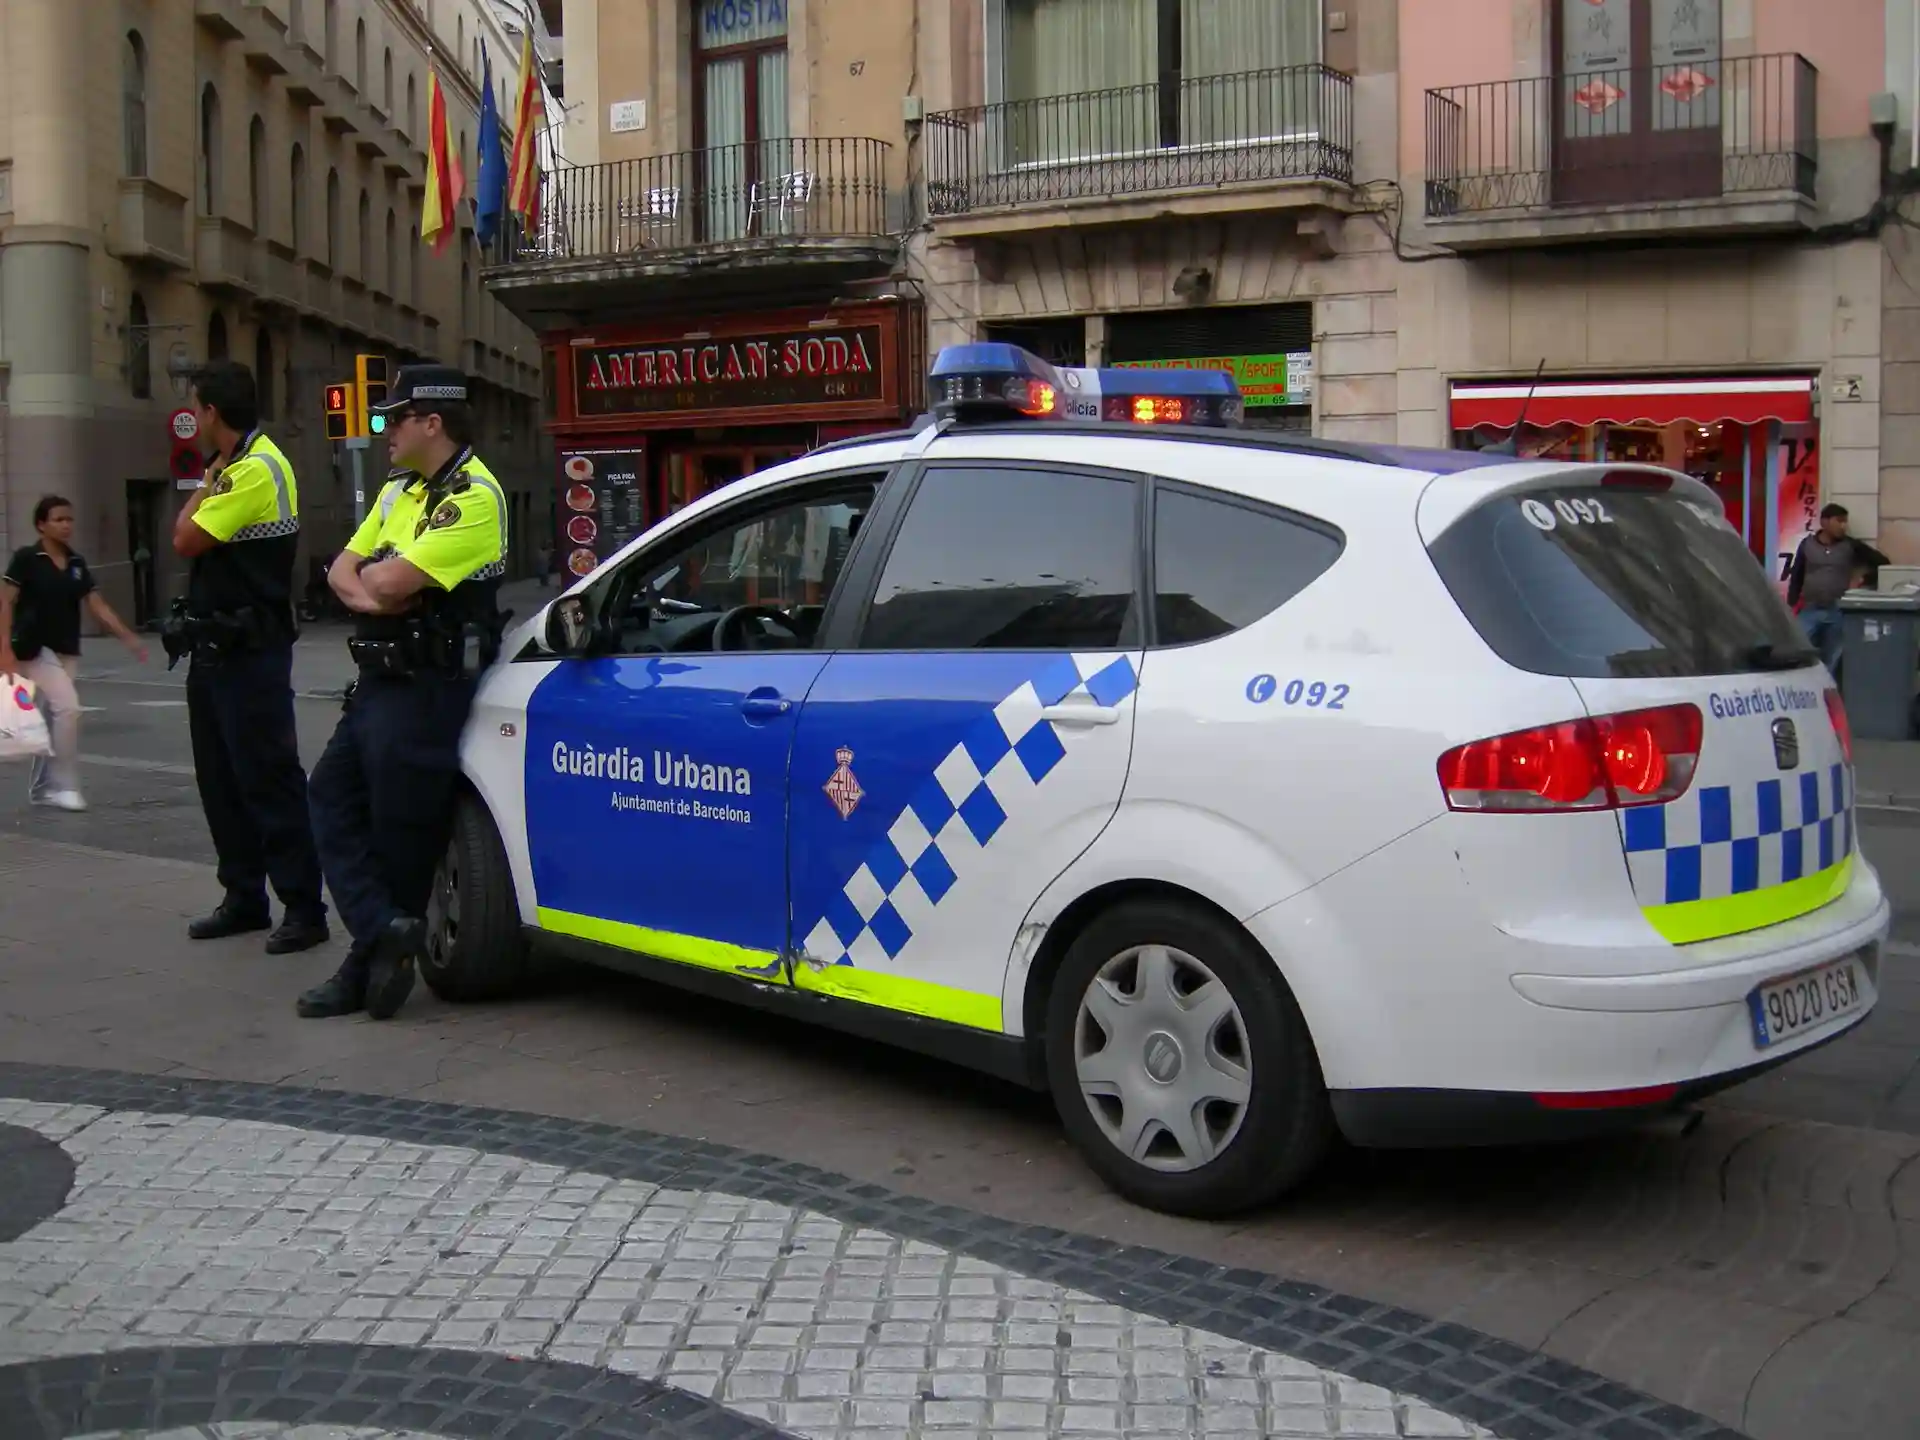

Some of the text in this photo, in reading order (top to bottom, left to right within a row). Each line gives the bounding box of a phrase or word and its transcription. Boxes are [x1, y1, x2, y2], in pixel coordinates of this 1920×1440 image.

[850, 61, 865, 76] 67
[1272, 394, 1286, 405] 69
[1554, 498, 1615, 525] 092
[1283, 679, 1350, 710] 092
[1709, 688, 1774, 719] Guàrdia
[552, 740, 751, 795] Guàrdia Urbana
[611, 791, 751, 824] Ajuntament de Barcelona
[1768, 978, 1823, 1034] 9020
